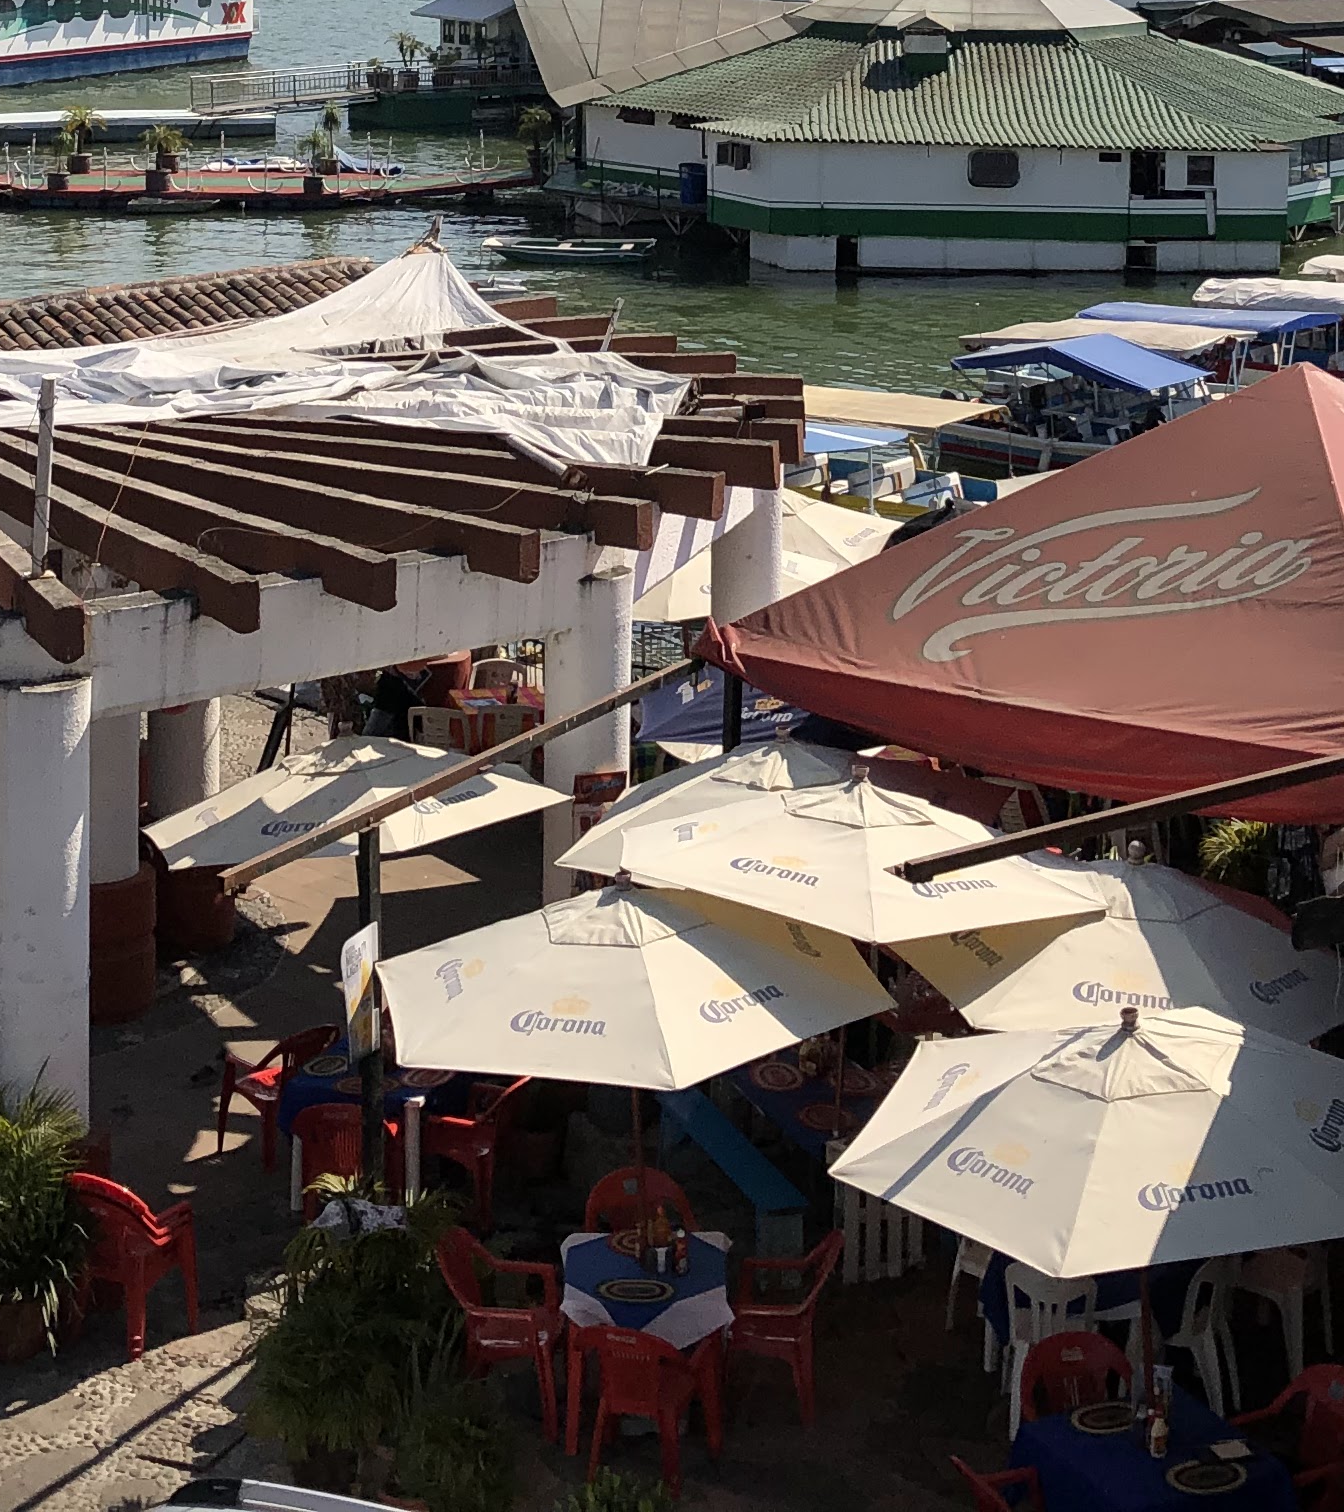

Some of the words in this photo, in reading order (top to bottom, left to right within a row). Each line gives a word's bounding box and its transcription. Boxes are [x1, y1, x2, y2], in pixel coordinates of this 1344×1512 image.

[892, 487, 1312, 662] Victoria
[413, 789, 482, 815] Corona
[260, 820, 325, 837] Coro
[729, 856, 820, 888] Corona
[911, 875, 998, 899] Corona
[1072, 980, 1174, 1011] Corona
[1249, 967, 1309, 1005] Corona
[699, 984, 786, 1024] Corona
[509, 1009, 607, 1037] Corona
[946, 1146, 1035, 1198] Corona
[1137, 1177, 1254, 1212] Corona
